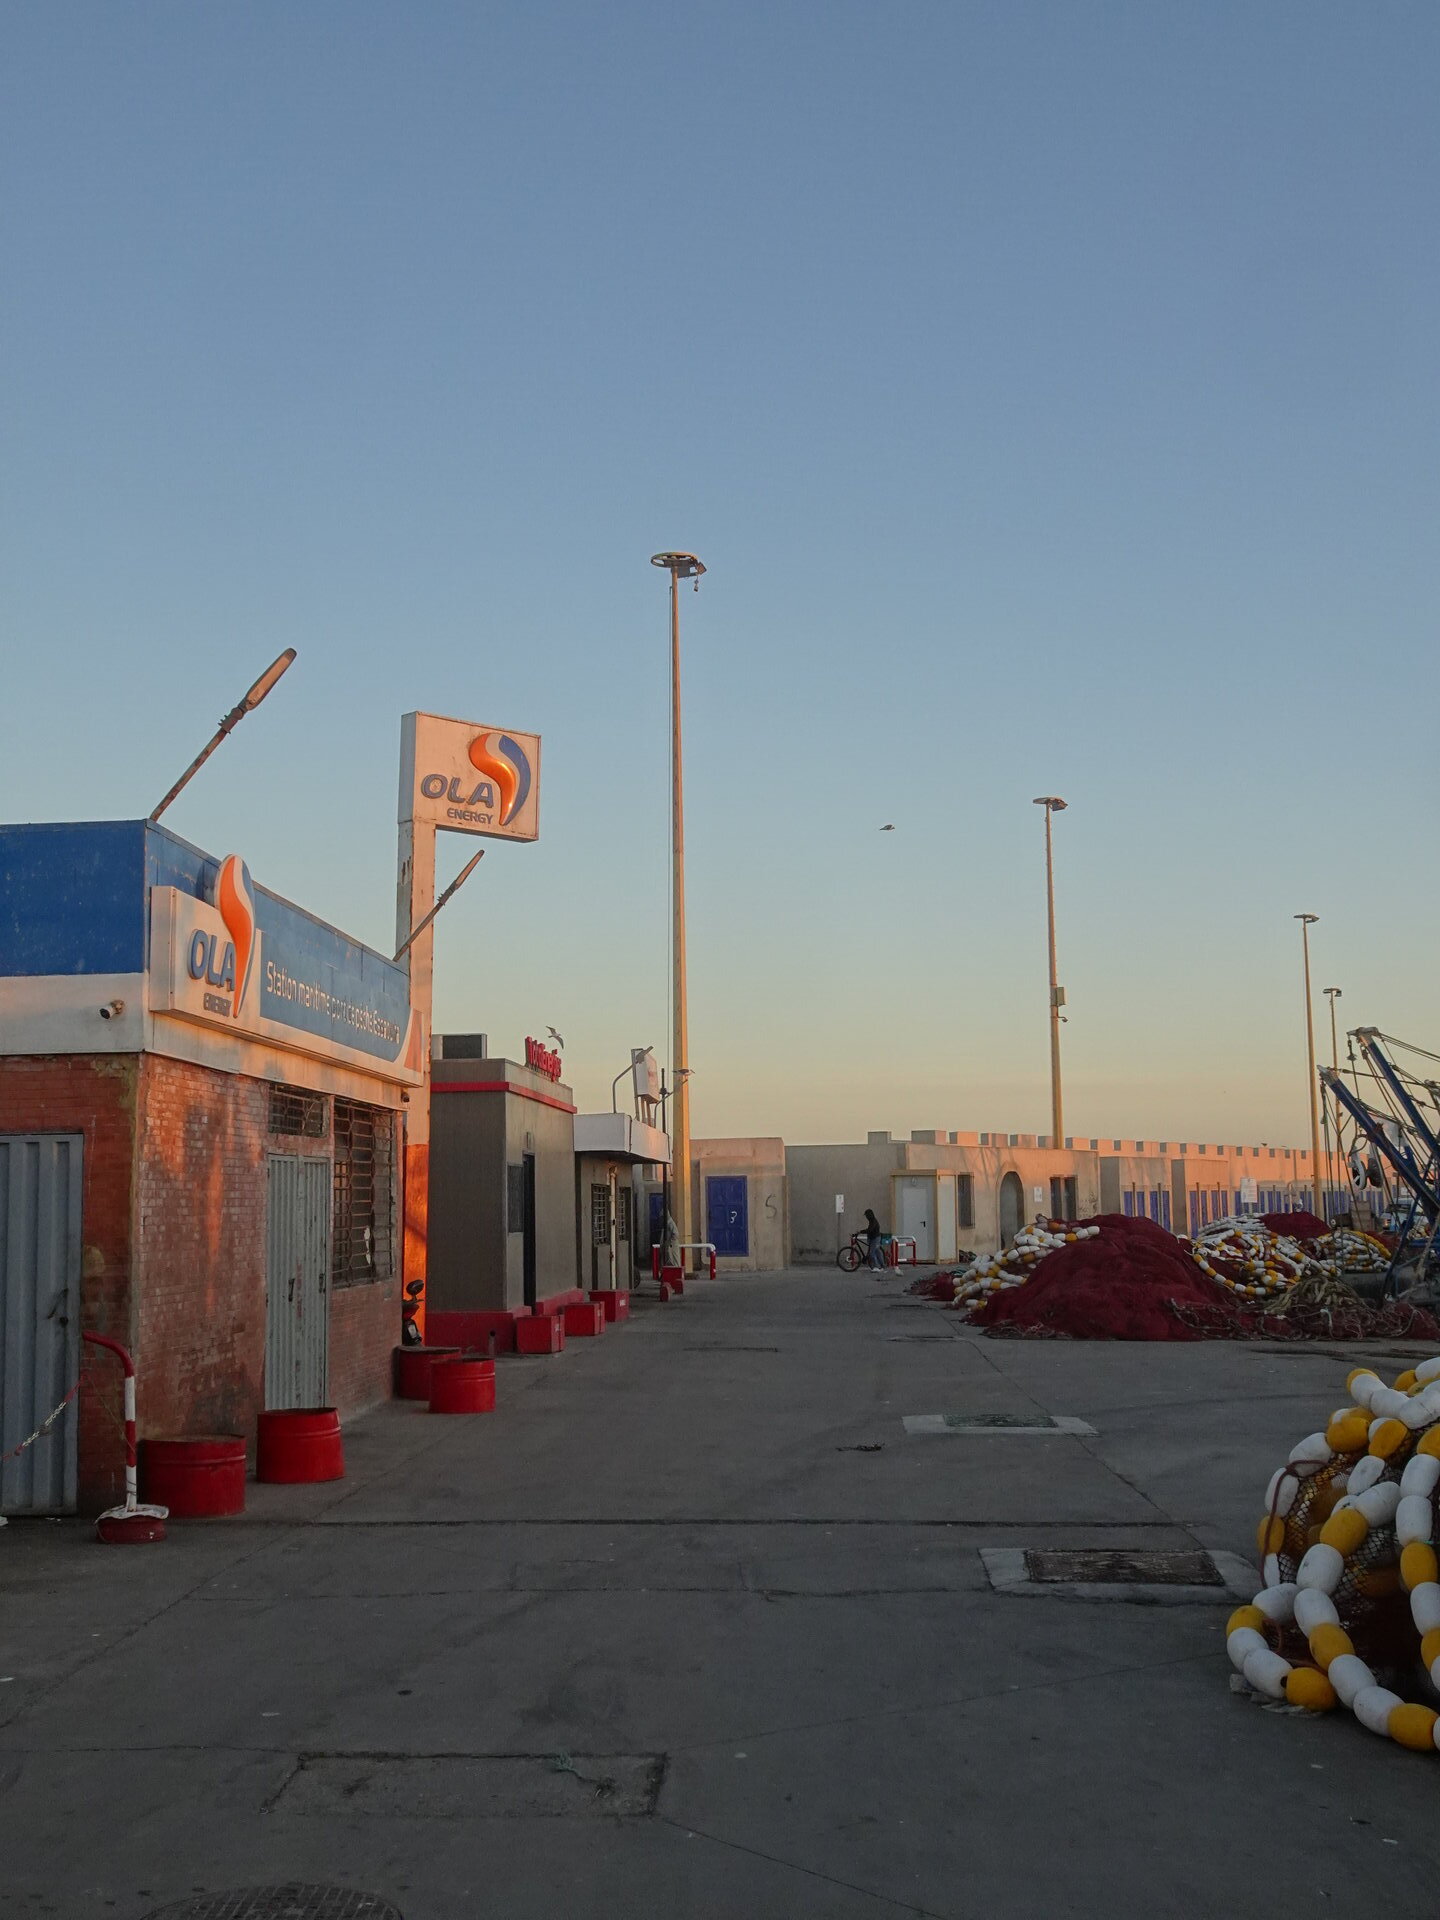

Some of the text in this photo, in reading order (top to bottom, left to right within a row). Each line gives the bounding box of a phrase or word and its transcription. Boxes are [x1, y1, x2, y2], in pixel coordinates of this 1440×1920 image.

[421, 773, 494, 808] OLA
[447, 807, 493, 824] ENERGY
[187, 929, 236, 992] OLA
[266, 961, 297, 1002] Station
